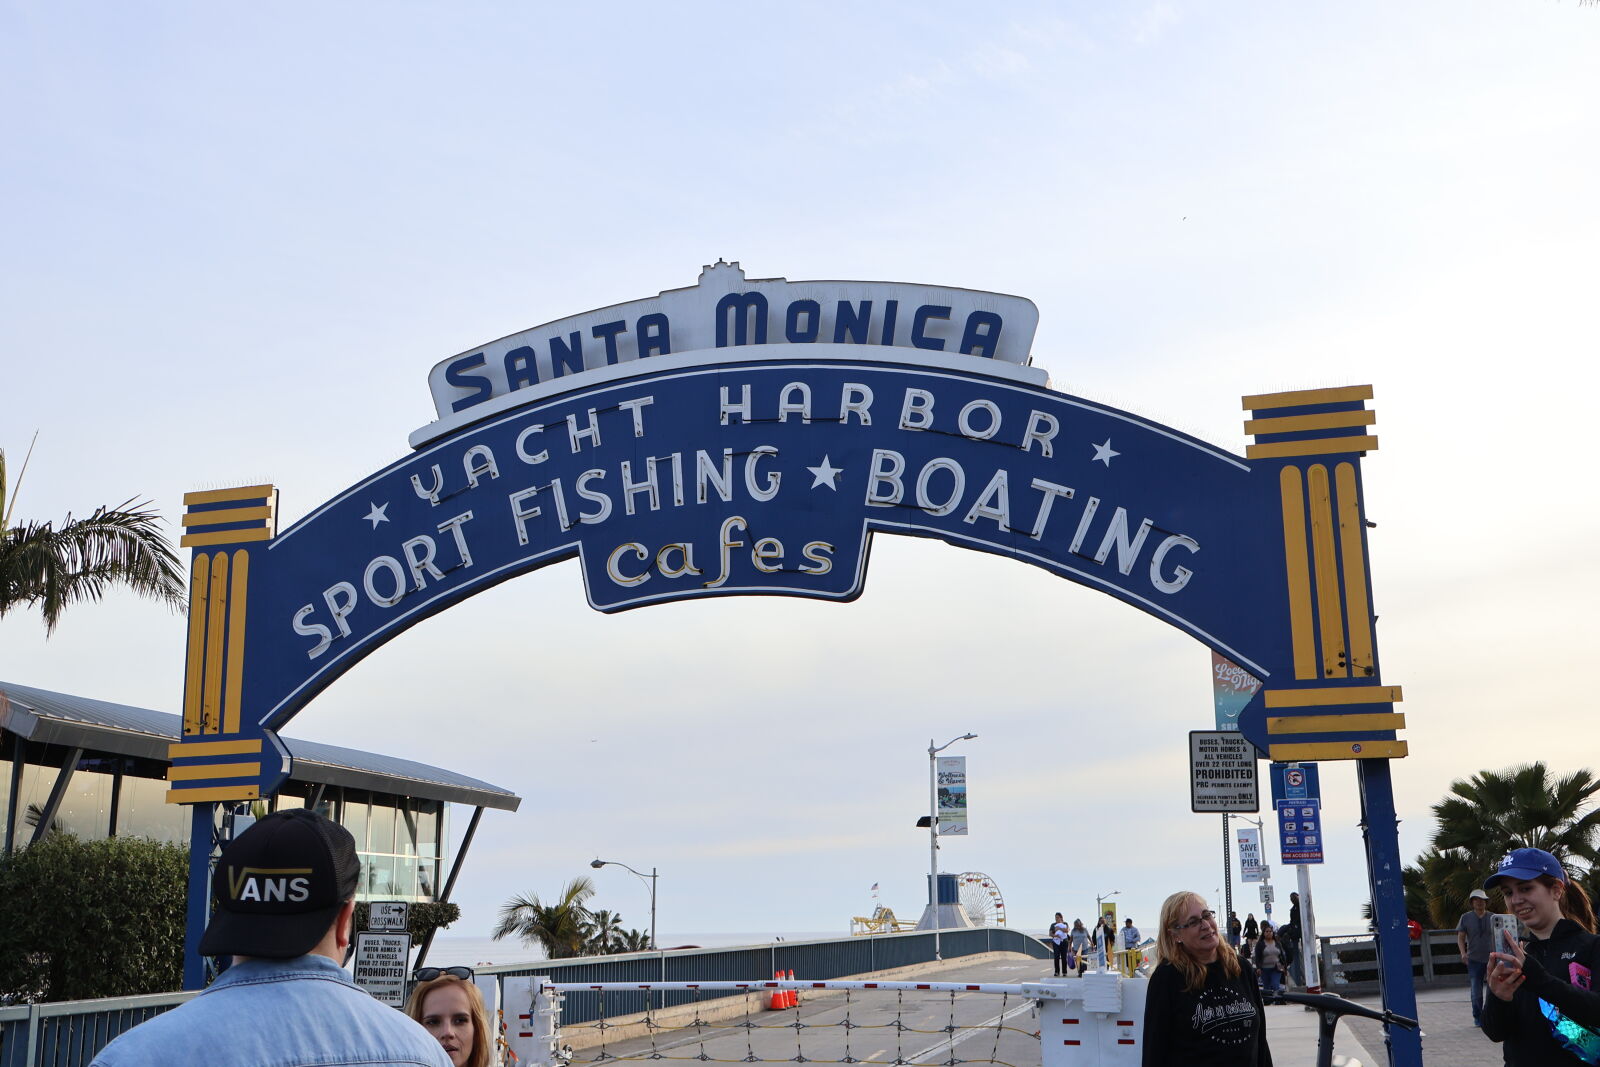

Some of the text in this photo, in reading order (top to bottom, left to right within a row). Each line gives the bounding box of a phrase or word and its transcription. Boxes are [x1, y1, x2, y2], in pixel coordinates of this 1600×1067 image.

[445, 290, 1004, 413] SANTA MONICA
[410, 381, 1060, 506] YACHT HARBOR
[292, 446, 1201, 660] SPORT FISHING BOATING
[606, 516, 836, 589] cafes
[1196, 769, 1252, 779] PROHIBITED
[1240, 844, 1257, 852] SAVE
[1242, 859, 1259, 867] PIER
[228, 865, 312, 902] VANS
[380, 906, 392, 914] USE
[371, 917, 404, 926] CROSSWALK
[357, 967, 404, 977] PROHIBITED
